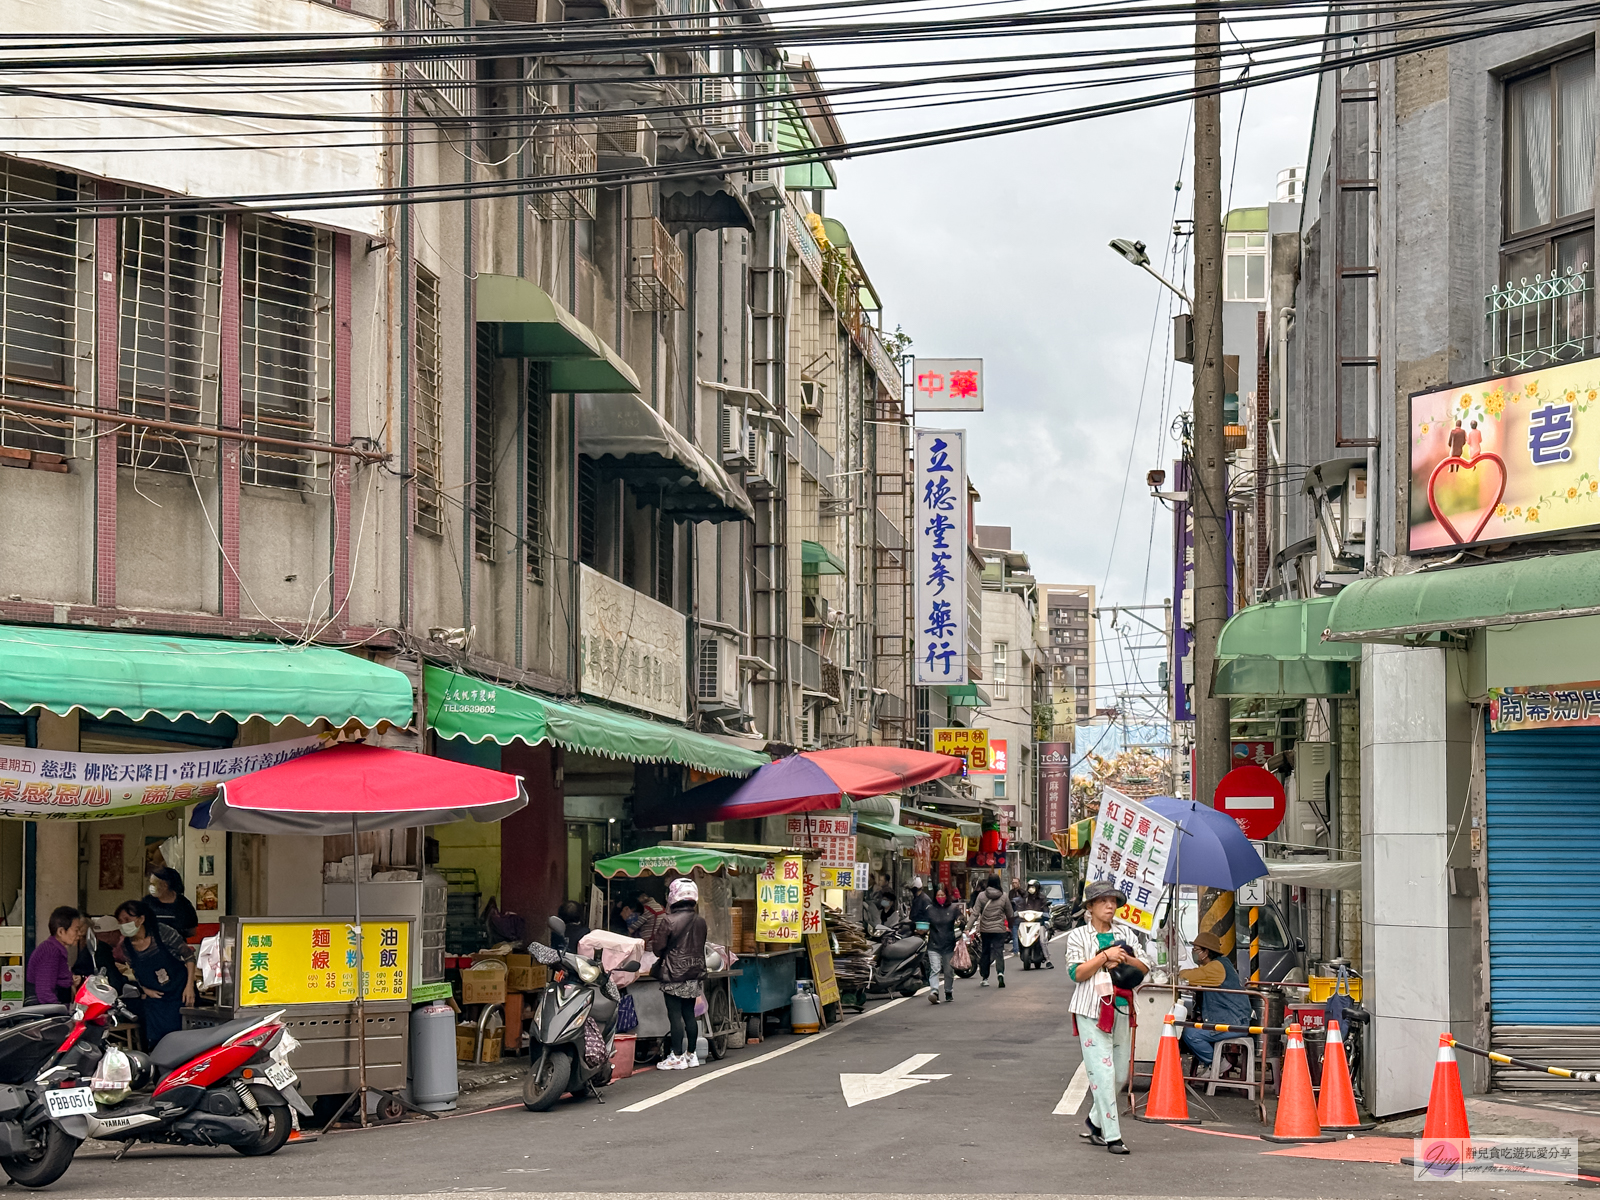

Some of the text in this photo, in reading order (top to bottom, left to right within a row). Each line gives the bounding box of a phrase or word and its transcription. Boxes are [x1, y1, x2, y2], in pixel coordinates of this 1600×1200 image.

[917, 370, 979, 399] 中藥
[1529, 404, 1572, 464] 老
[938, 731, 969, 742] 南門
[40, 759, 77, 780] 慈悲
[1102, 821, 1161, 865] 綠豆薏仁
[760, 884, 799, 904] 小籠包
[760, 909, 799, 923] 手工製作
[247, 935, 273, 948] 媽媽
[380, 927, 398, 968] 油飯
[311, 929, 331, 970] 麵線
[249, 952, 269, 994] 素食
[325, 972, 336, 980] 35
[393, 970, 403, 978] 40
[325, 980, 336, 989] 45
[393, 978, 403, 986] 55
[393, 986, 403, 994] 80
[49, 1094, 94, 1111] PBB-0516
[104, 1119, 131, 1128] YAMAHA
